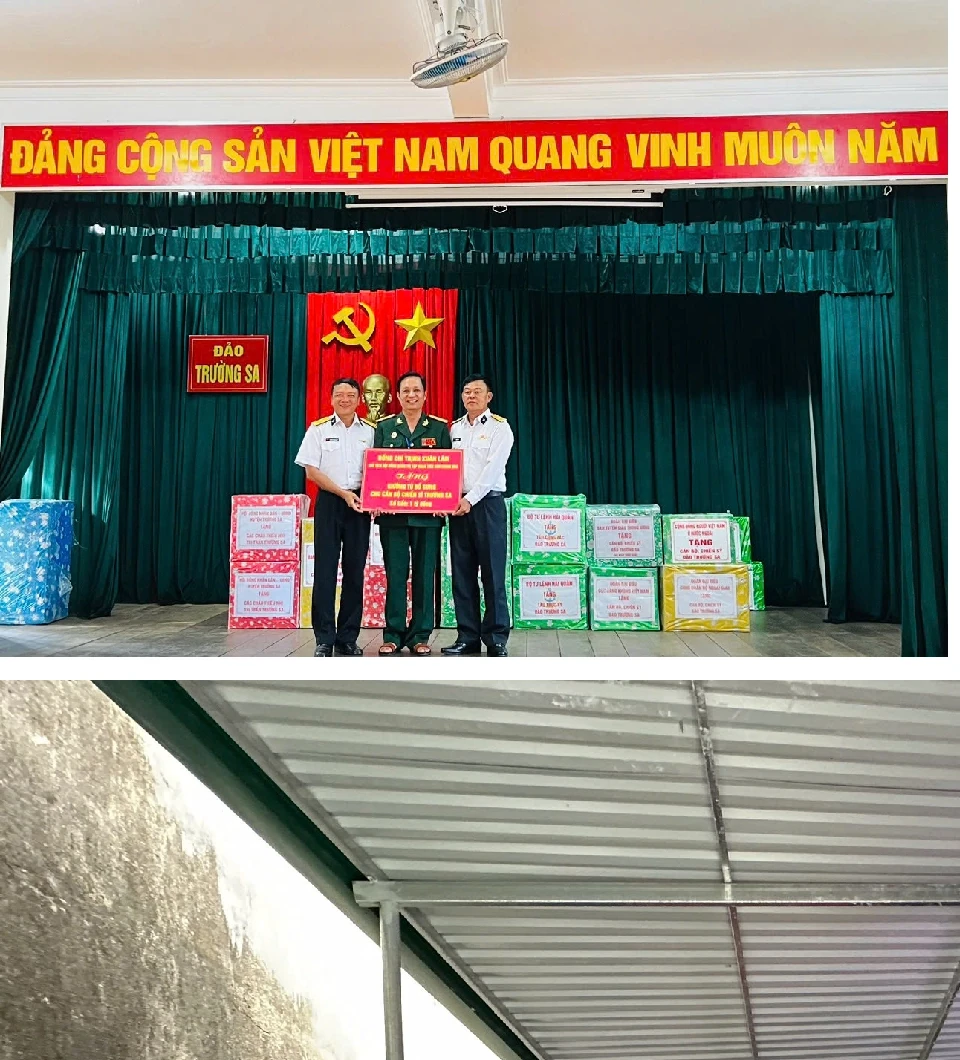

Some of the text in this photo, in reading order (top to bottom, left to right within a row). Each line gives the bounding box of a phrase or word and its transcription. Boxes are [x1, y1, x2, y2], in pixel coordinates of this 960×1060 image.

[10, 121, 939, 181] ĐẢNG CỘNG SẢN VIỆT NAM QUANG VINH MUÔN NĂM
[213, 342, 244, 357] ĐẢO
[195, 360, 260, 384] TRƯỜNG SA
